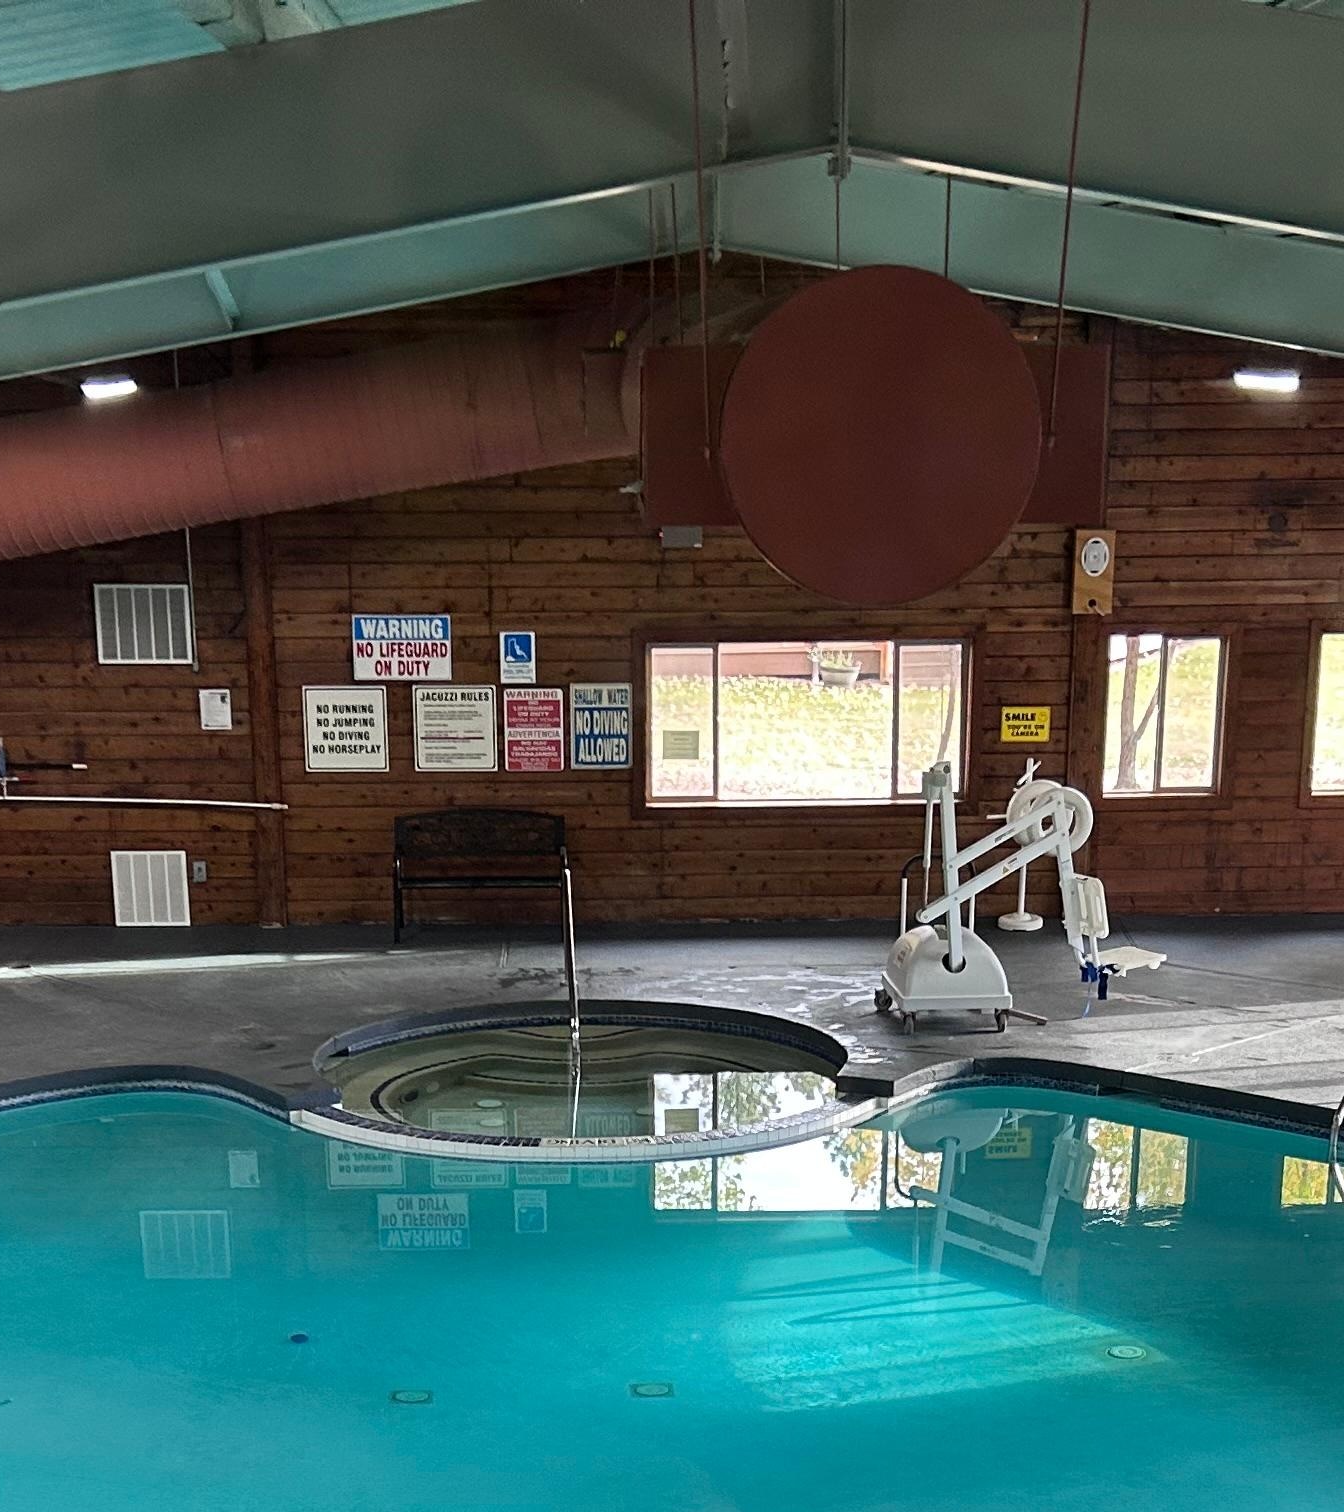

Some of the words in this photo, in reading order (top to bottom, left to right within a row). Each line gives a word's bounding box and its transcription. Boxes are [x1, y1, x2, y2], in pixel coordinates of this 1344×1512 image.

[360, 618, 444, 640] WARNING
[356, 642, 374, 658] NO
[380, 642, 448, 658] LIFEGUARD
[375, 660, 392, 676] ON
[398, 660, 431, 676] DUTY
[420, 692, 458, 702] JACUZZI
[460, 692, 490, 702] RULES
[505, 690, 558, 699] WARNING
[607, 688, 629, 705] WATER
[316, 704, 330, 714] NO
[332, 704, 374, 714] RUNNING
[1004, 712, 1037, 722] SMILE
[316, 718, 330, 728] NO
[332, 717, 375, 728] JUMPING
[575, 710, 591, 736] NO
[593, 710, 628, 736] DIVING
[322, 731, 336, 741] NO
[338, 731, 370, 741] DIVING
[507, 730, 561, 739] ADVERTENCIA
[312, 744, 326, 754] NO
[328, 744, 382, 754] HORSEPLAY
[578, 737, 627, 762] ALLOWED
